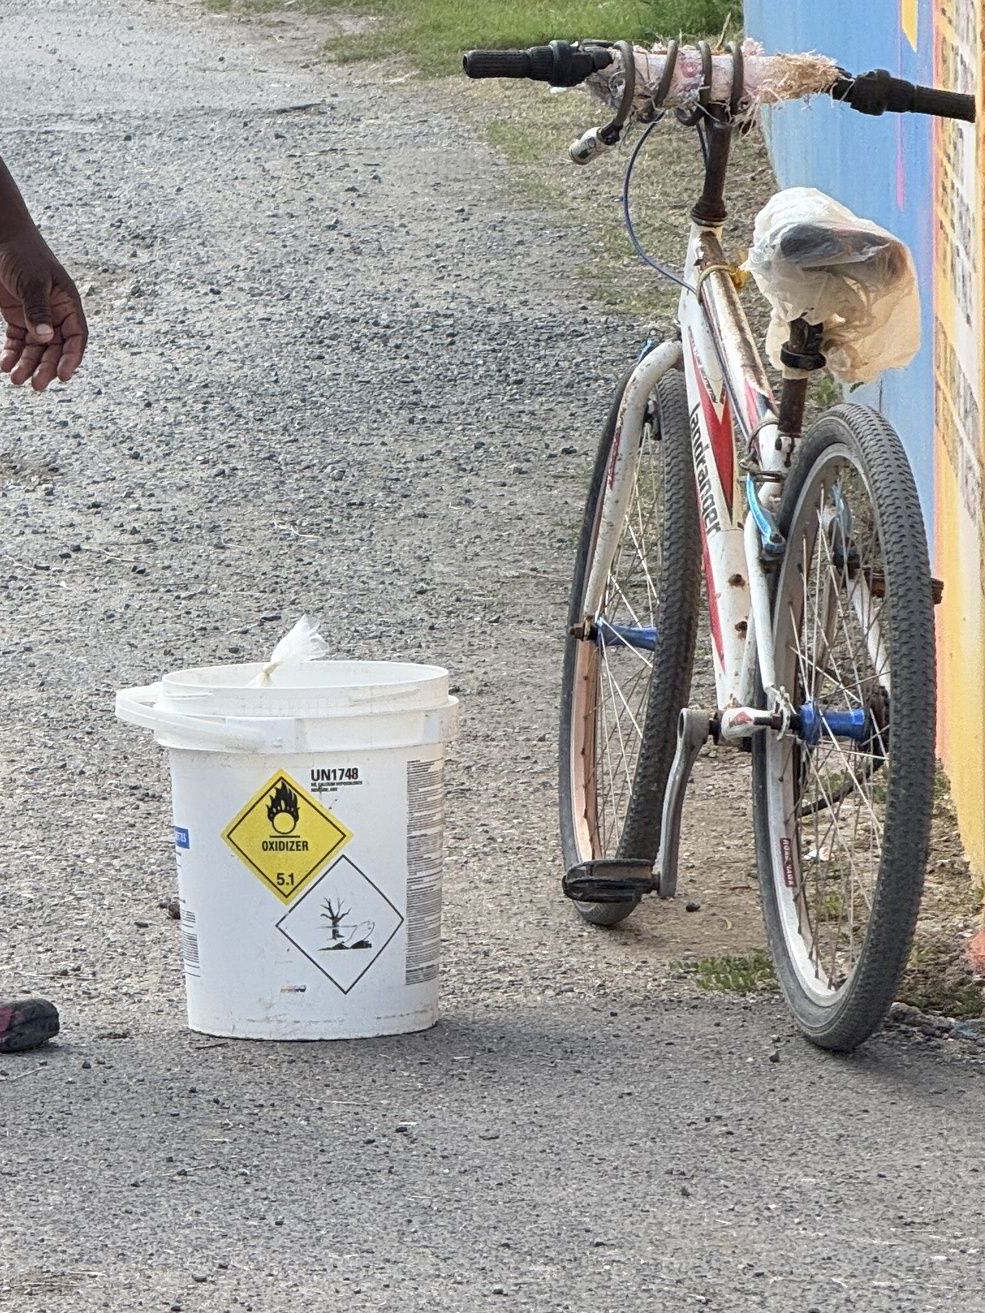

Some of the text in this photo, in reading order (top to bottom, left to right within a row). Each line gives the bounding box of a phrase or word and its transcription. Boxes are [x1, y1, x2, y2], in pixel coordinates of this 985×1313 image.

[689, 401, 722, 535] landranger
[310, 767, 359, 781] UN1748
[261, 840, 309, 852] OXIDIZER
[276, 872, 294, 886] 5.1
